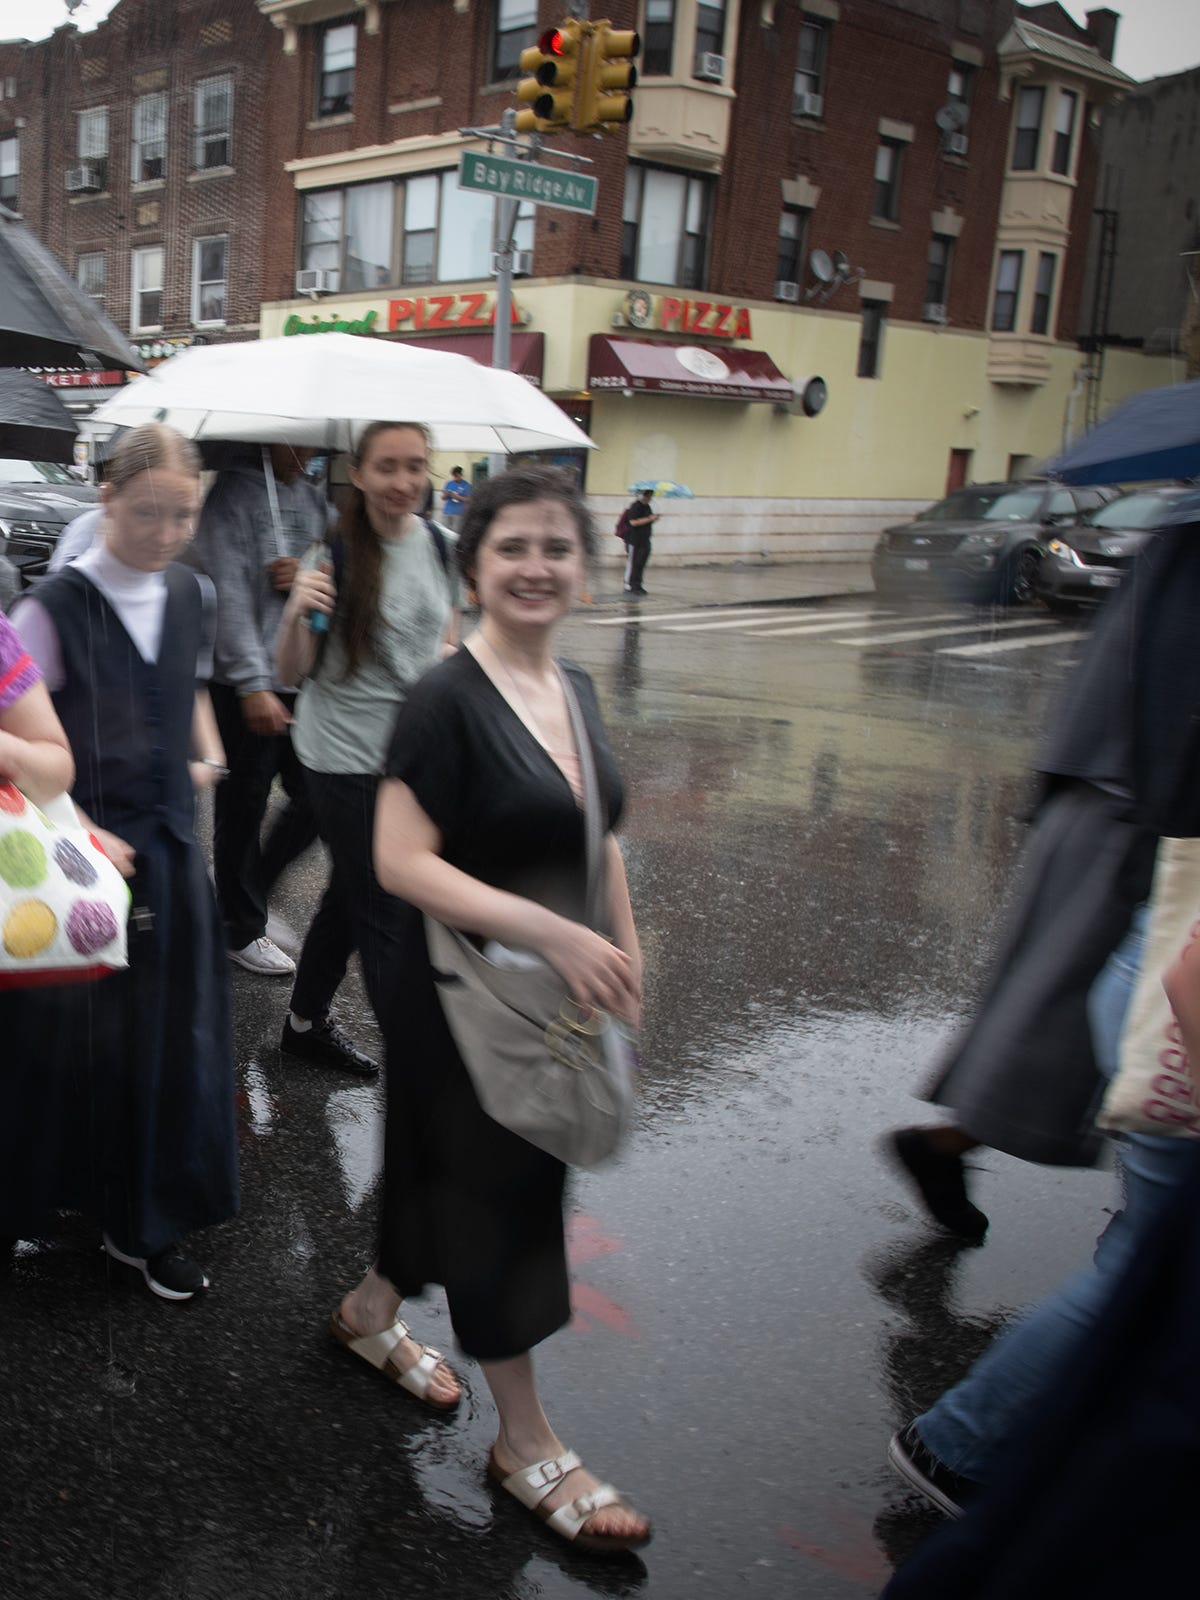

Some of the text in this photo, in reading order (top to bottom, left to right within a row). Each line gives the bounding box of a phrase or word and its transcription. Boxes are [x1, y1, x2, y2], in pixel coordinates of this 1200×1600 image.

[474, 162, 586, 201] Bay Ridge Av
[661, 297, 752, 340] PIZZA
[589, 376, 628, 388] PIZZA
